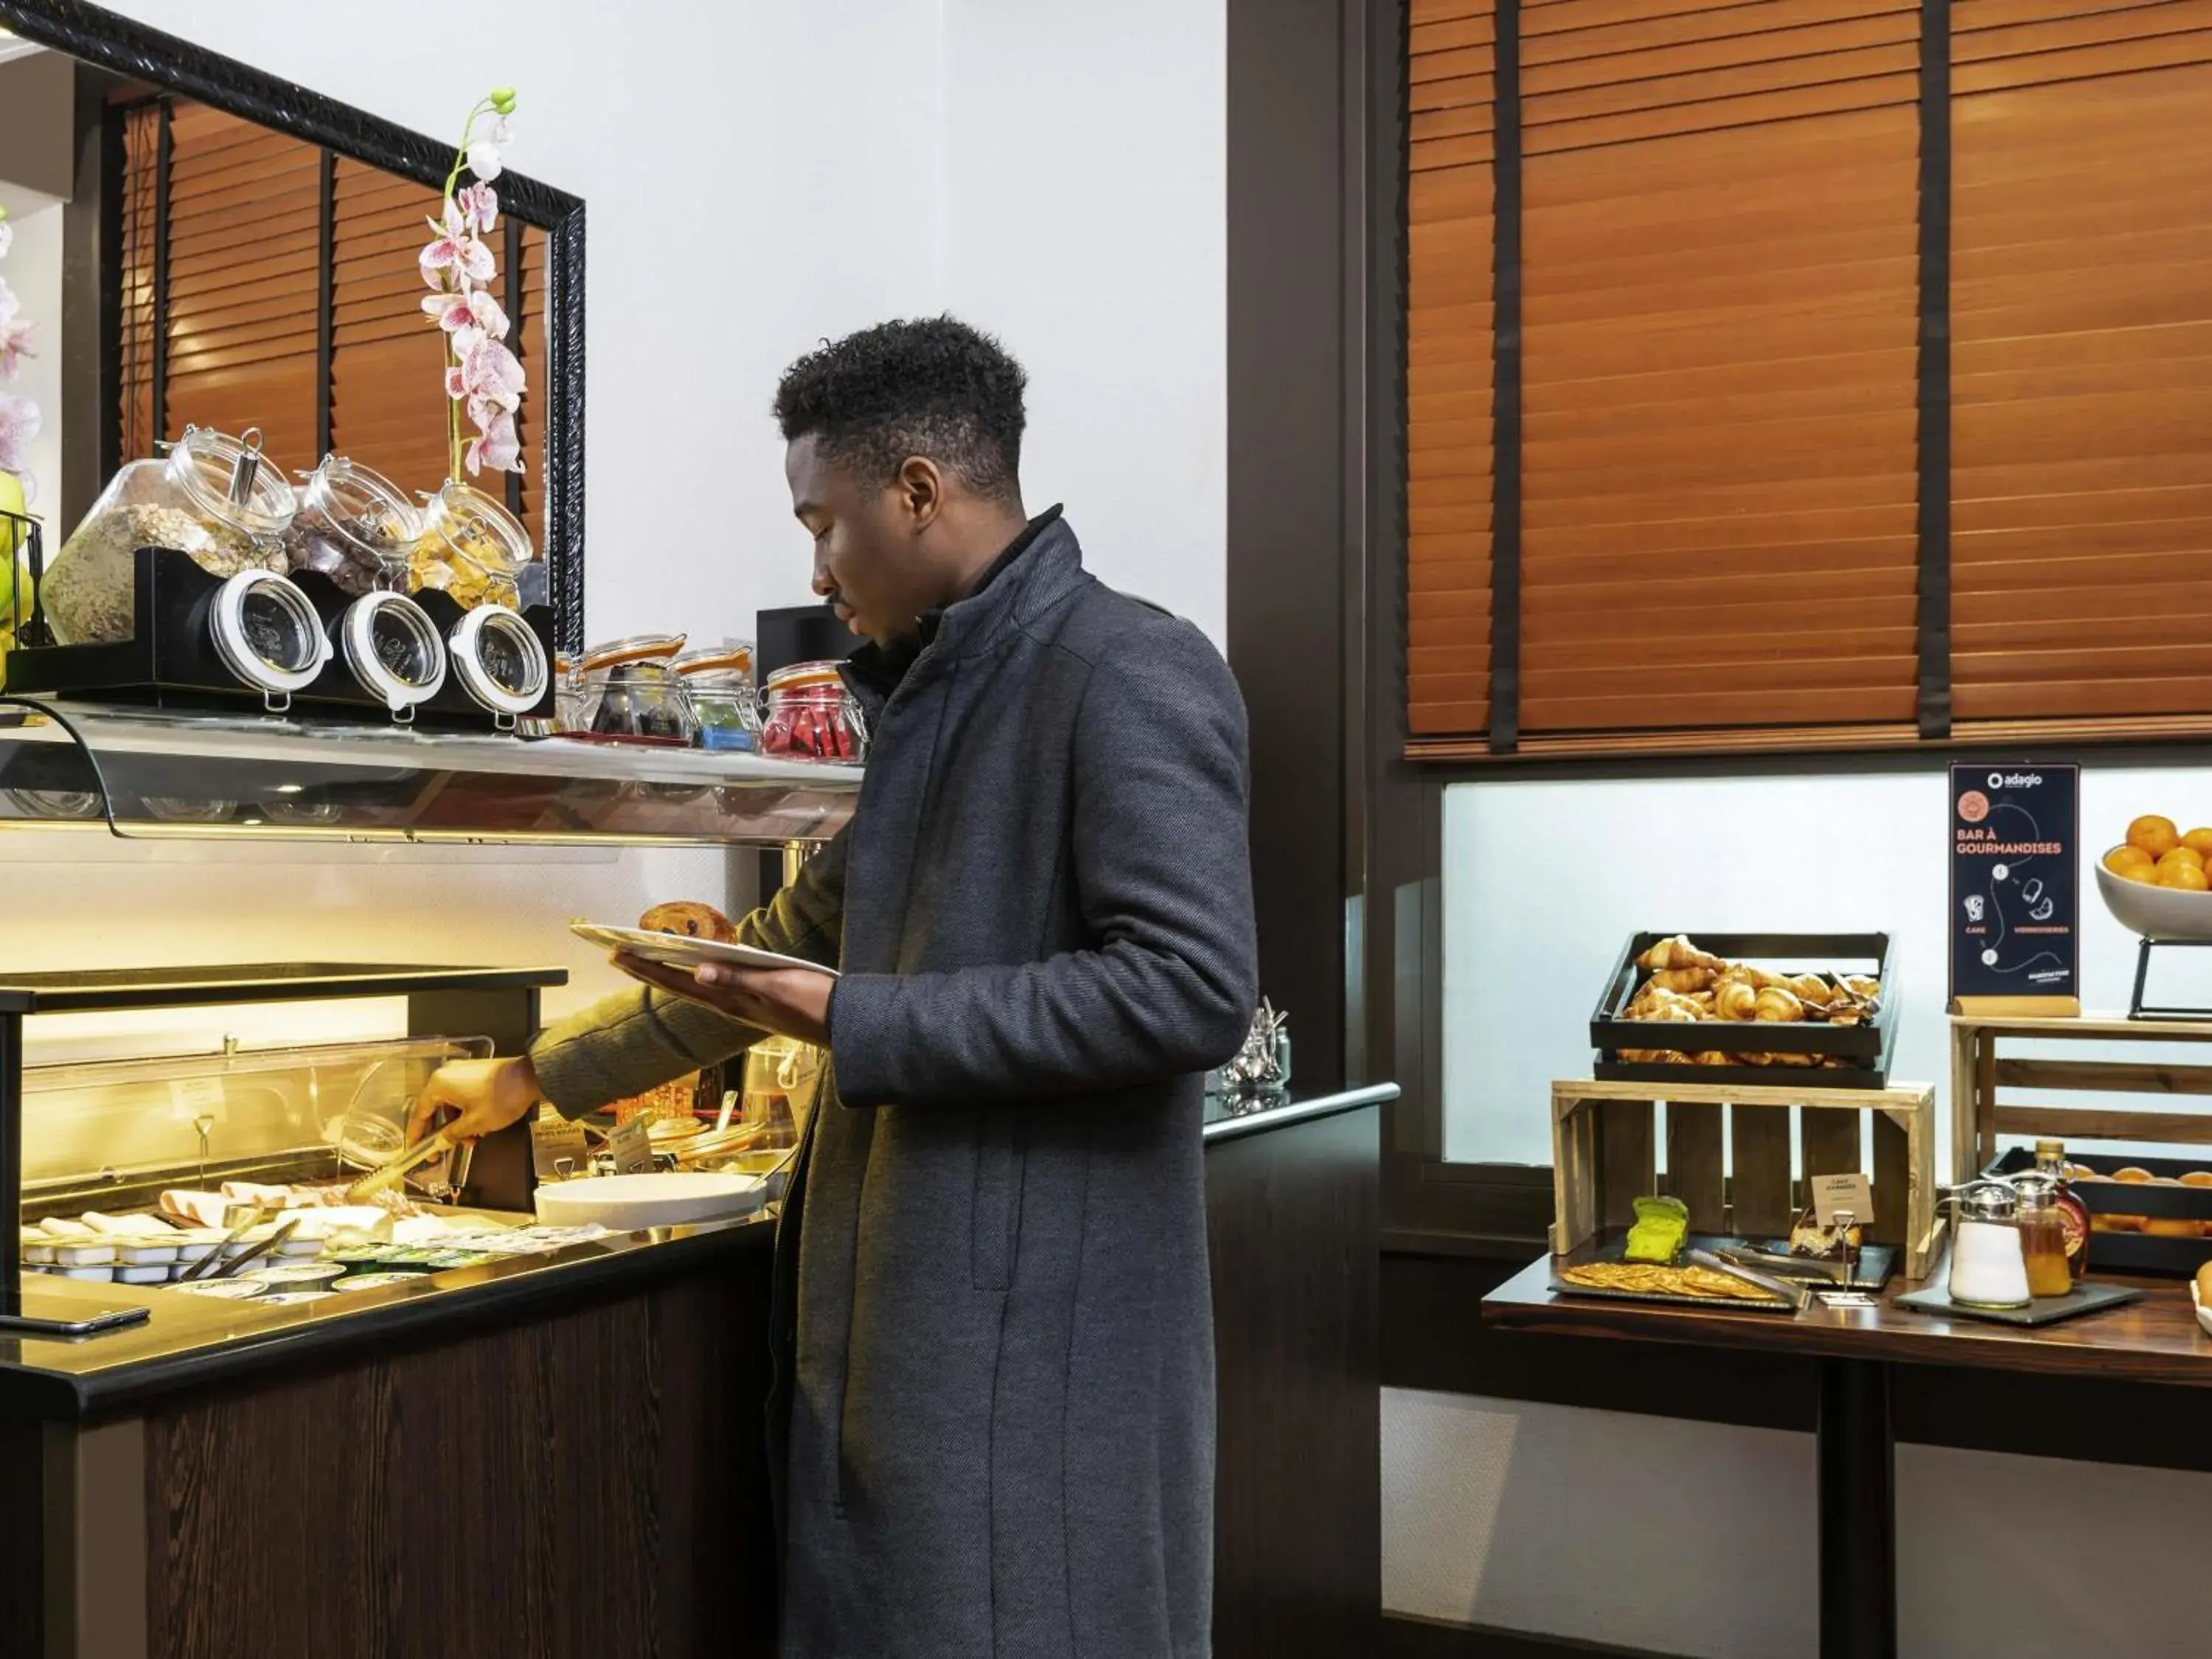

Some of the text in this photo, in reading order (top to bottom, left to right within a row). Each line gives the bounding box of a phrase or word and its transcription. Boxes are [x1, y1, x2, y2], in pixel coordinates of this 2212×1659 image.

[2004, 773, 2042, 788] adagio
[1956, 829, 1984, 841] BAR
[1956, 843, 2062, 855] GOURMANDISES
